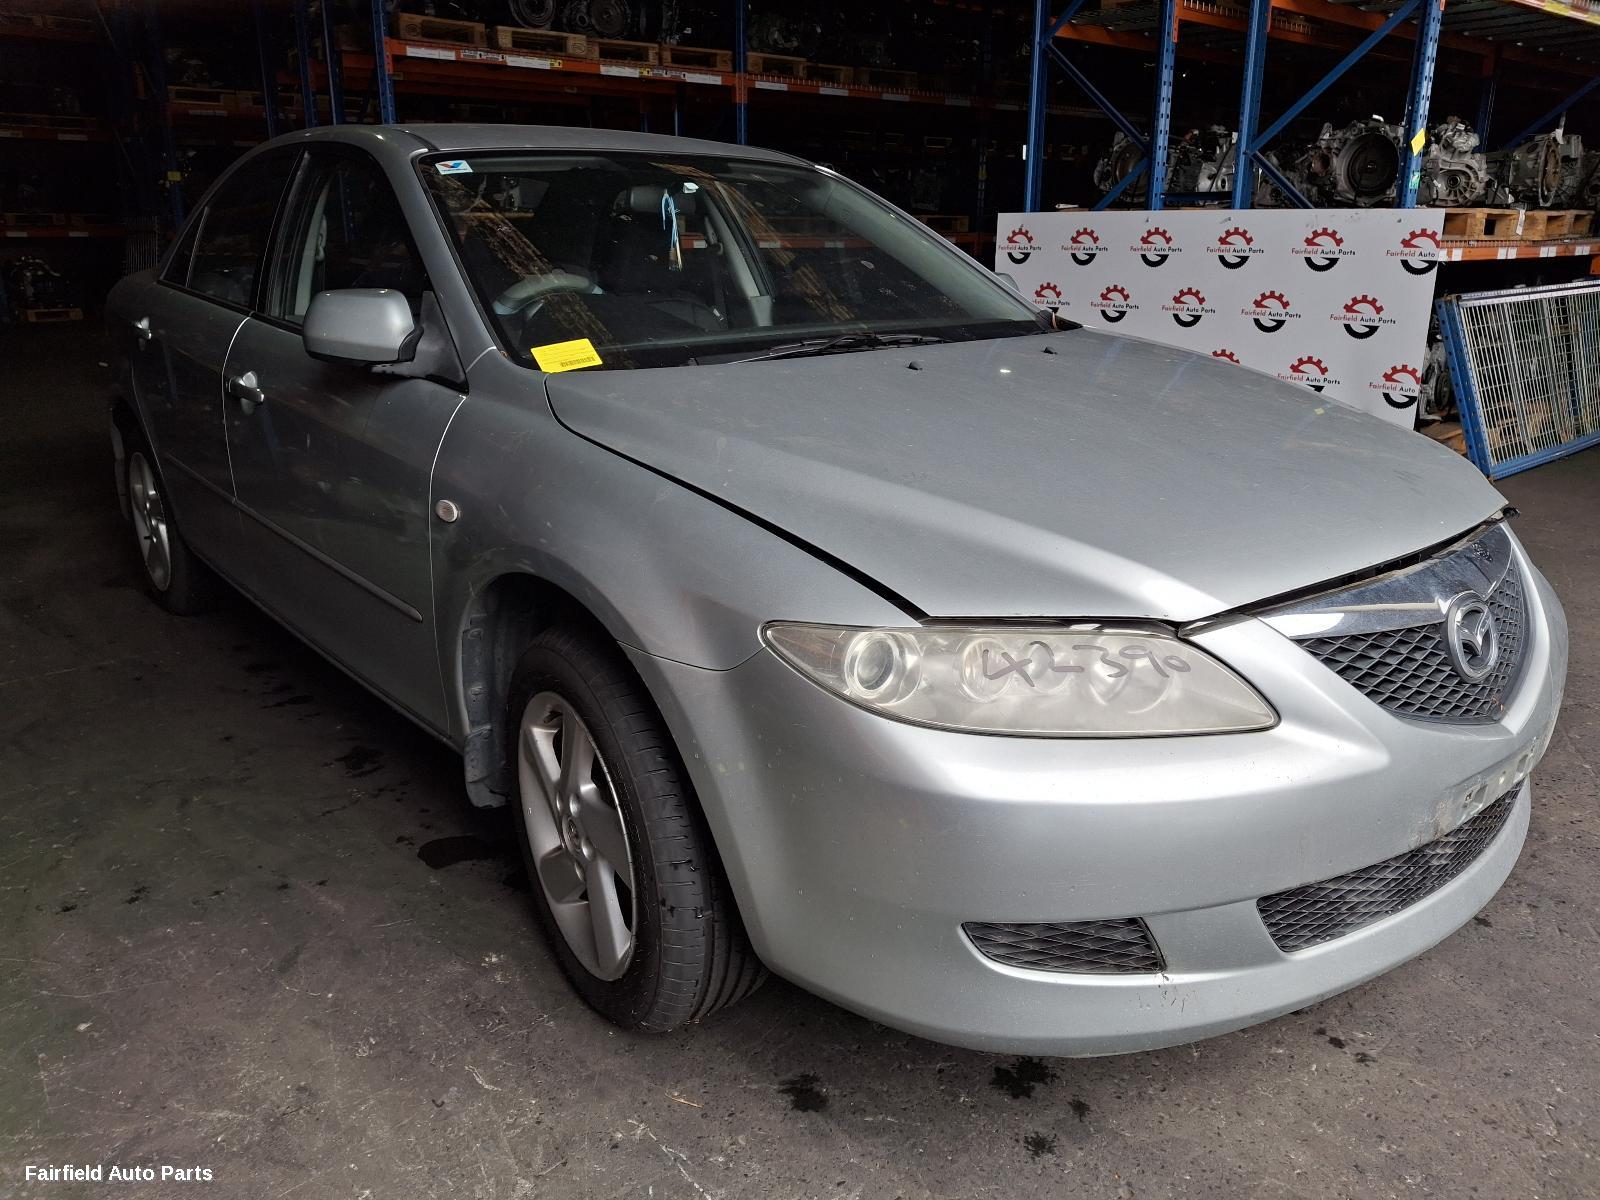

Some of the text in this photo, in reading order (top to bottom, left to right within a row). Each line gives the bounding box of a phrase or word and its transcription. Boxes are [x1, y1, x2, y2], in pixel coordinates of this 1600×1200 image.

[1291, 248, 1319, 256] Fairfield
[1386, 250, 1416, 258] Fairfield
[1090, 301, 1111, 309] Fairfield
[1161, 304, 1185, 312] Fairfield
[1241, 308, 1267, 317] Fairfield
[1284, 311, 1302, 319] Parts
[1329, 313, 1358, 322] Fairfield
[1277, 373, 1341, 385] Fairfield Auto Parts
[1369, 382, 1416, 394] Fairfield Auto
